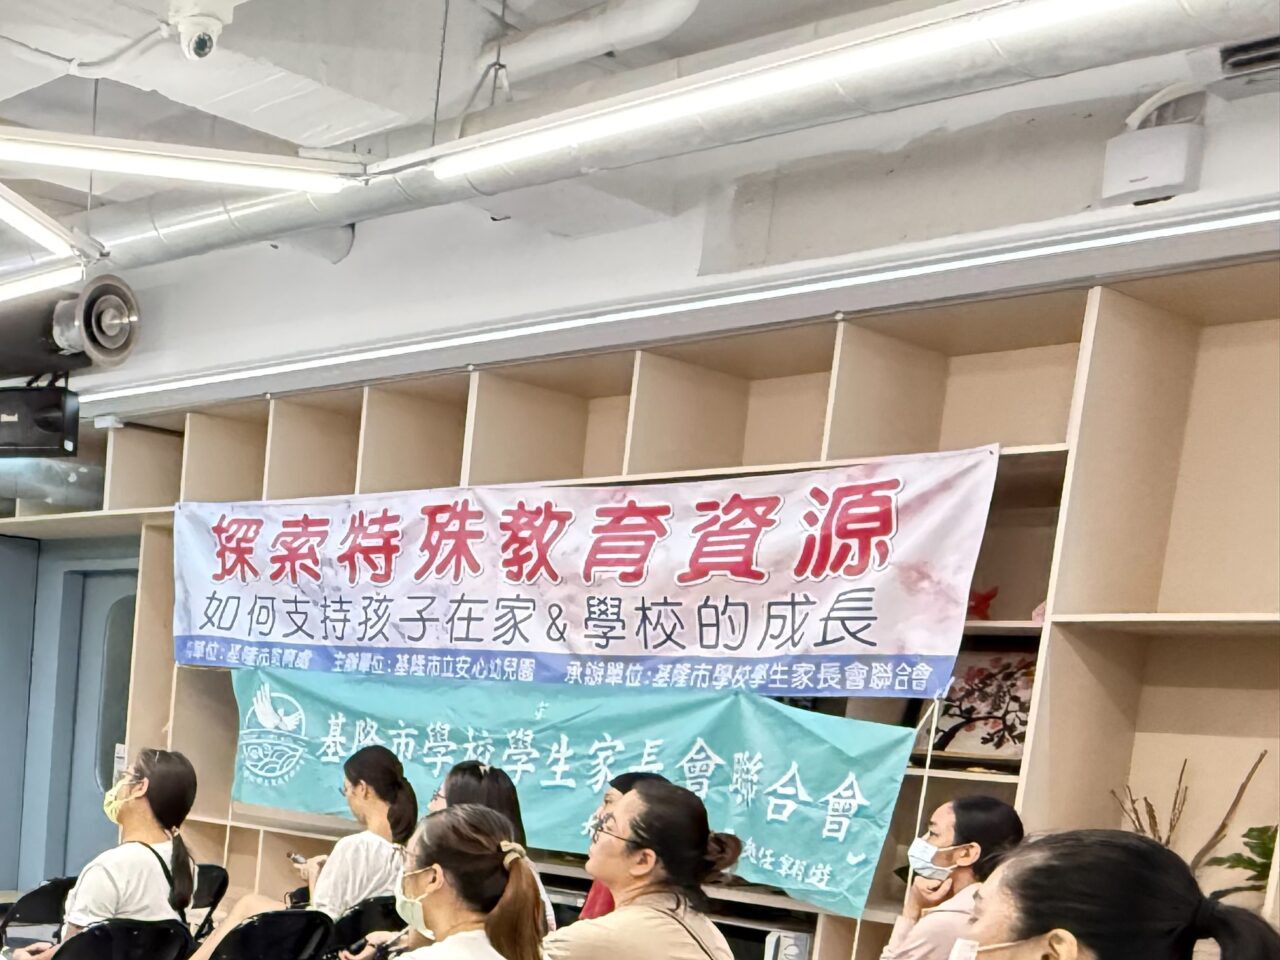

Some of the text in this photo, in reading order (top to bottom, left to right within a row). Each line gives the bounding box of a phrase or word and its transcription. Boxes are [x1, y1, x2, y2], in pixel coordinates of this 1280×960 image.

[211, 478, 902, 585] 探索特殊教育資源
[198, 587, 878, 650] 如何支持孩子在家&學校的成長
